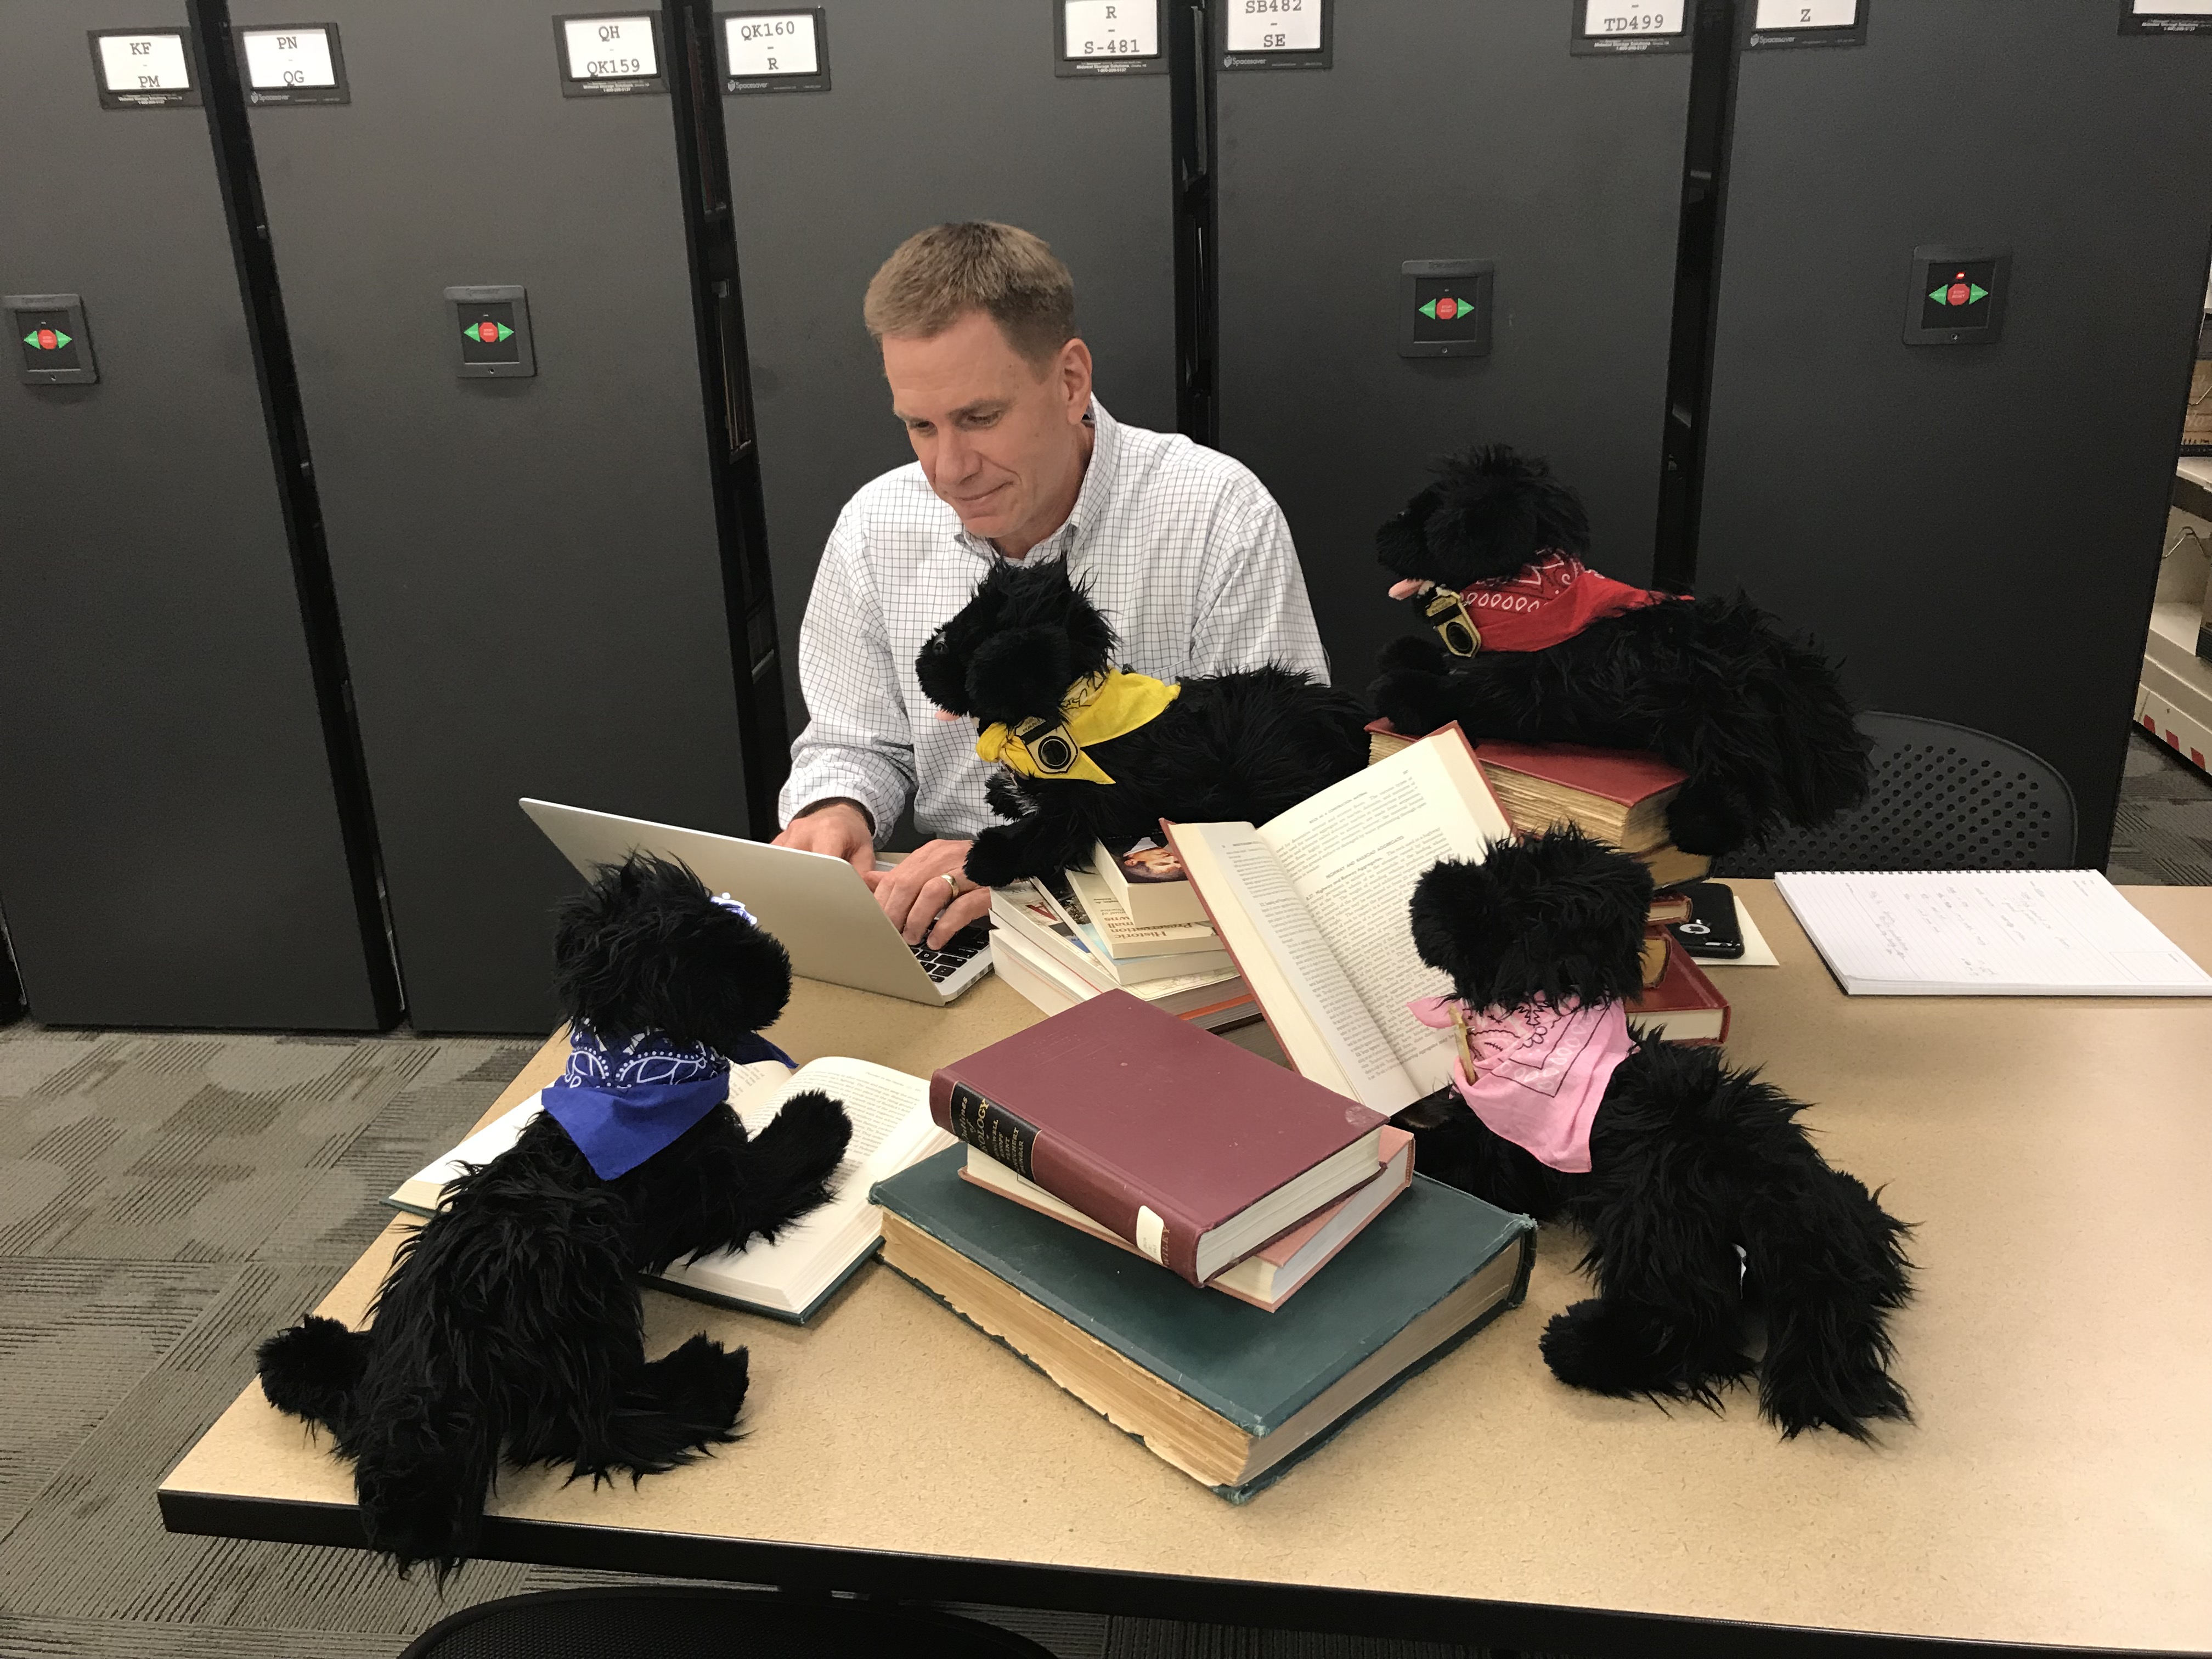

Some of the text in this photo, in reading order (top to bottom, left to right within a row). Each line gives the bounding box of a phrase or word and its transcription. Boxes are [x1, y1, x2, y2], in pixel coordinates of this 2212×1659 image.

[1105, 6, 1117, 19] R
[1245, 0, 1302, 14] SB482
[1800, 8, 1811, 22] Z
[1604, 14, 1664, 31] TD499
[598, 26, 620, 42] QH
[741, 20, 795, 41] QK160
[276, 36, 298, 50] PN
[1084, 39, 1140, 54] S-481
[1263, 34, 1285, 48] SE
[129, 42, 152, 55] KF
[586, 58, 640, 77] QK159
[767, 57, 779, 71] R
[1232, 57, 1267, 67] Spacesaver
[137, 75, 161, 88] PM
[283, 70, 305, 87] QG
[736, 82, 769, 91] Spacesaver
[1115, 931, 1167, 939] Historic
[977, 1098, 990, 1152] EOLOGY
[1162, 1224, 1170, 1266] WILEY
